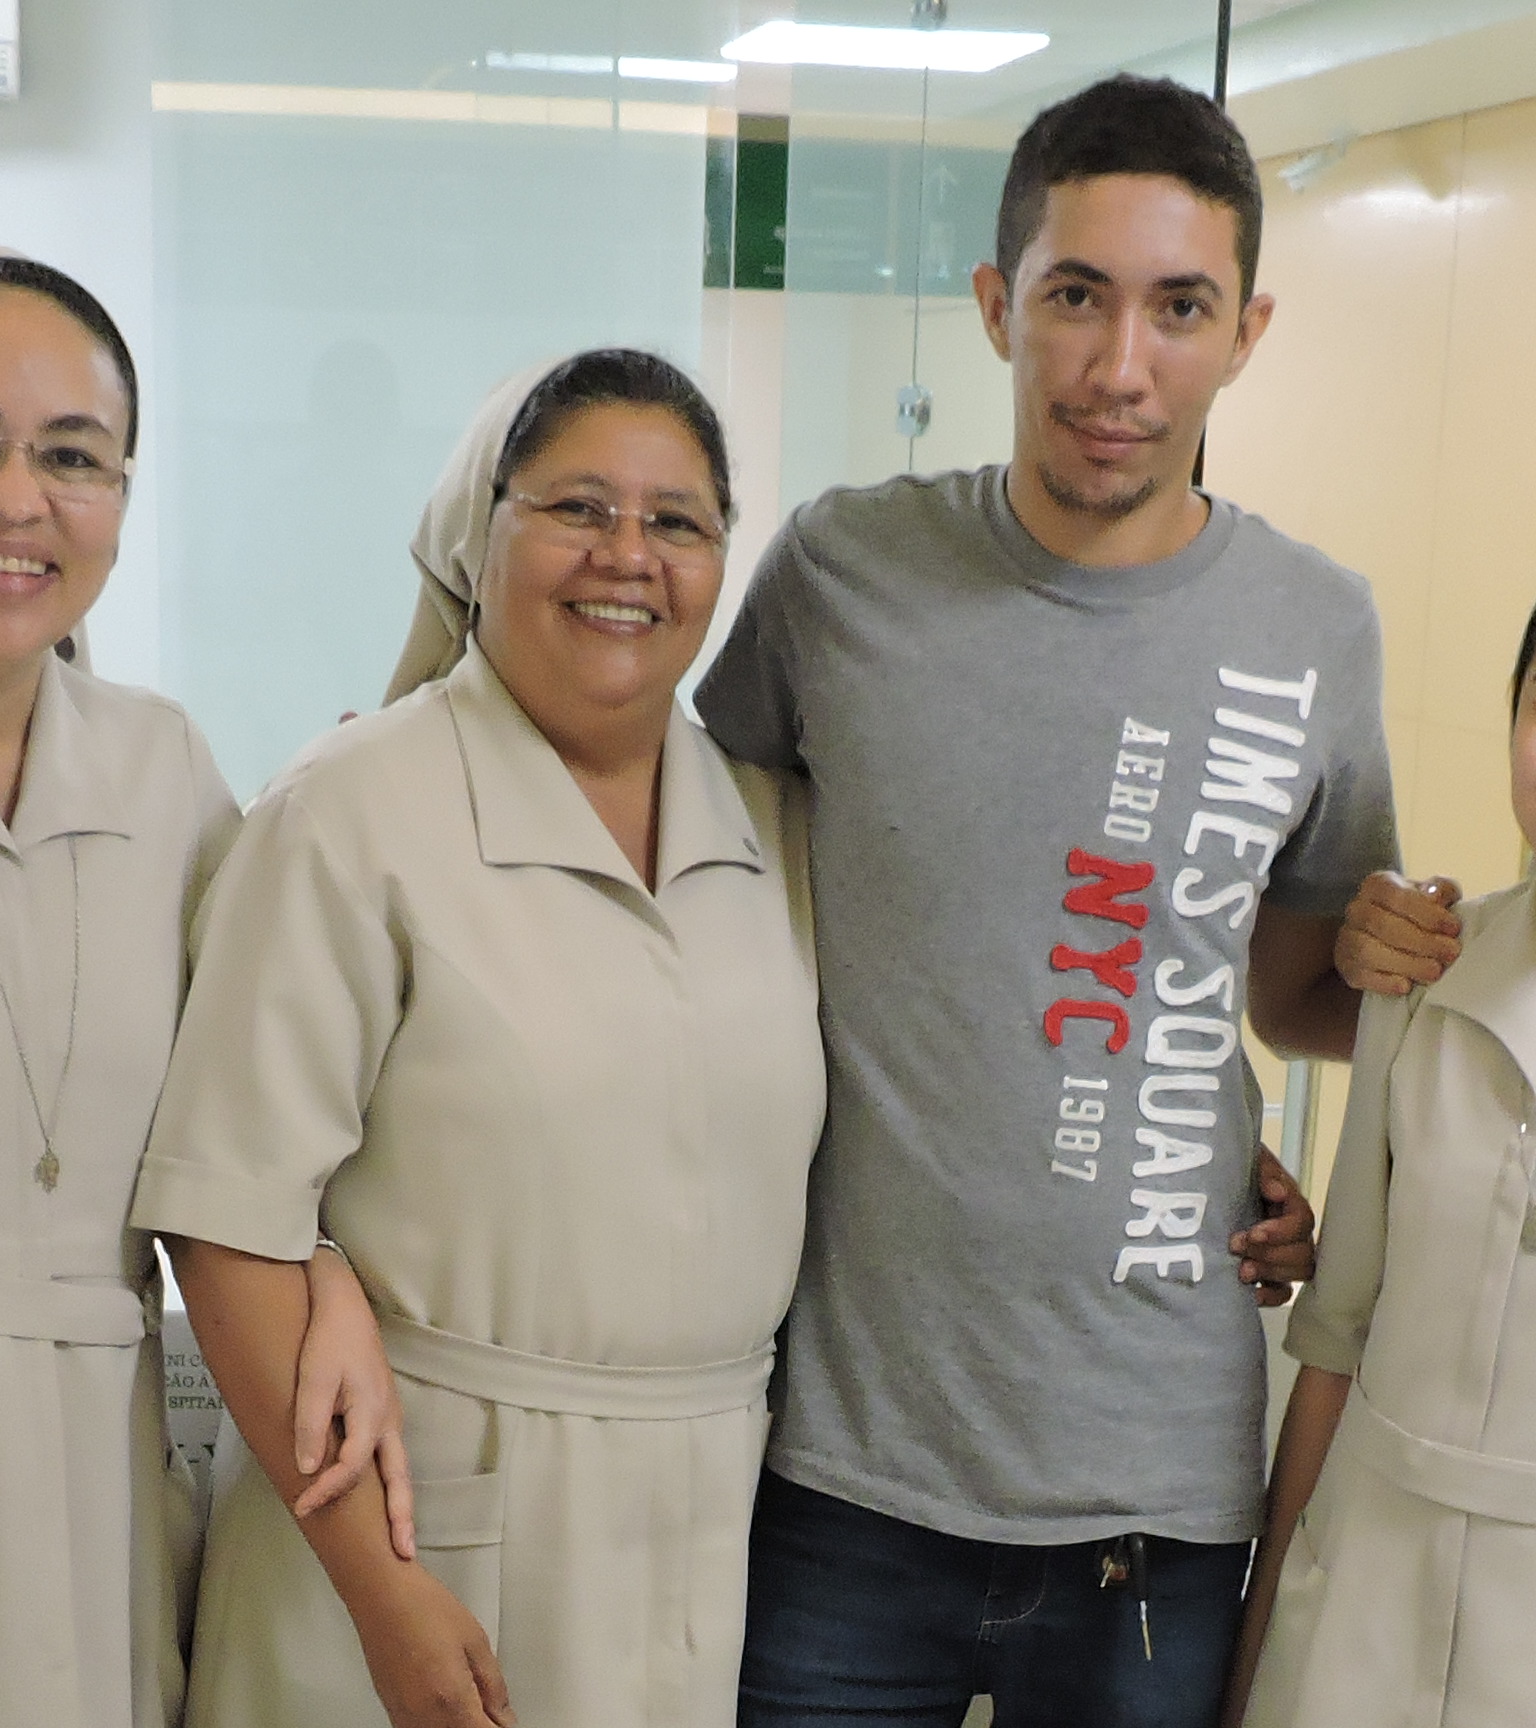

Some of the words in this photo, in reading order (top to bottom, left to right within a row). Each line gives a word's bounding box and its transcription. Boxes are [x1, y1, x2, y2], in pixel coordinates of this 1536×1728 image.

[1103, 716, 1171, 844] AERO
[1171, 667, 1318, 930] TIMES
[1043, 846, 1156, 1055] NYC
[1050, 1075, 1109, 1183] 1987
[1113, 957, 1237, 1285] SQUARE
